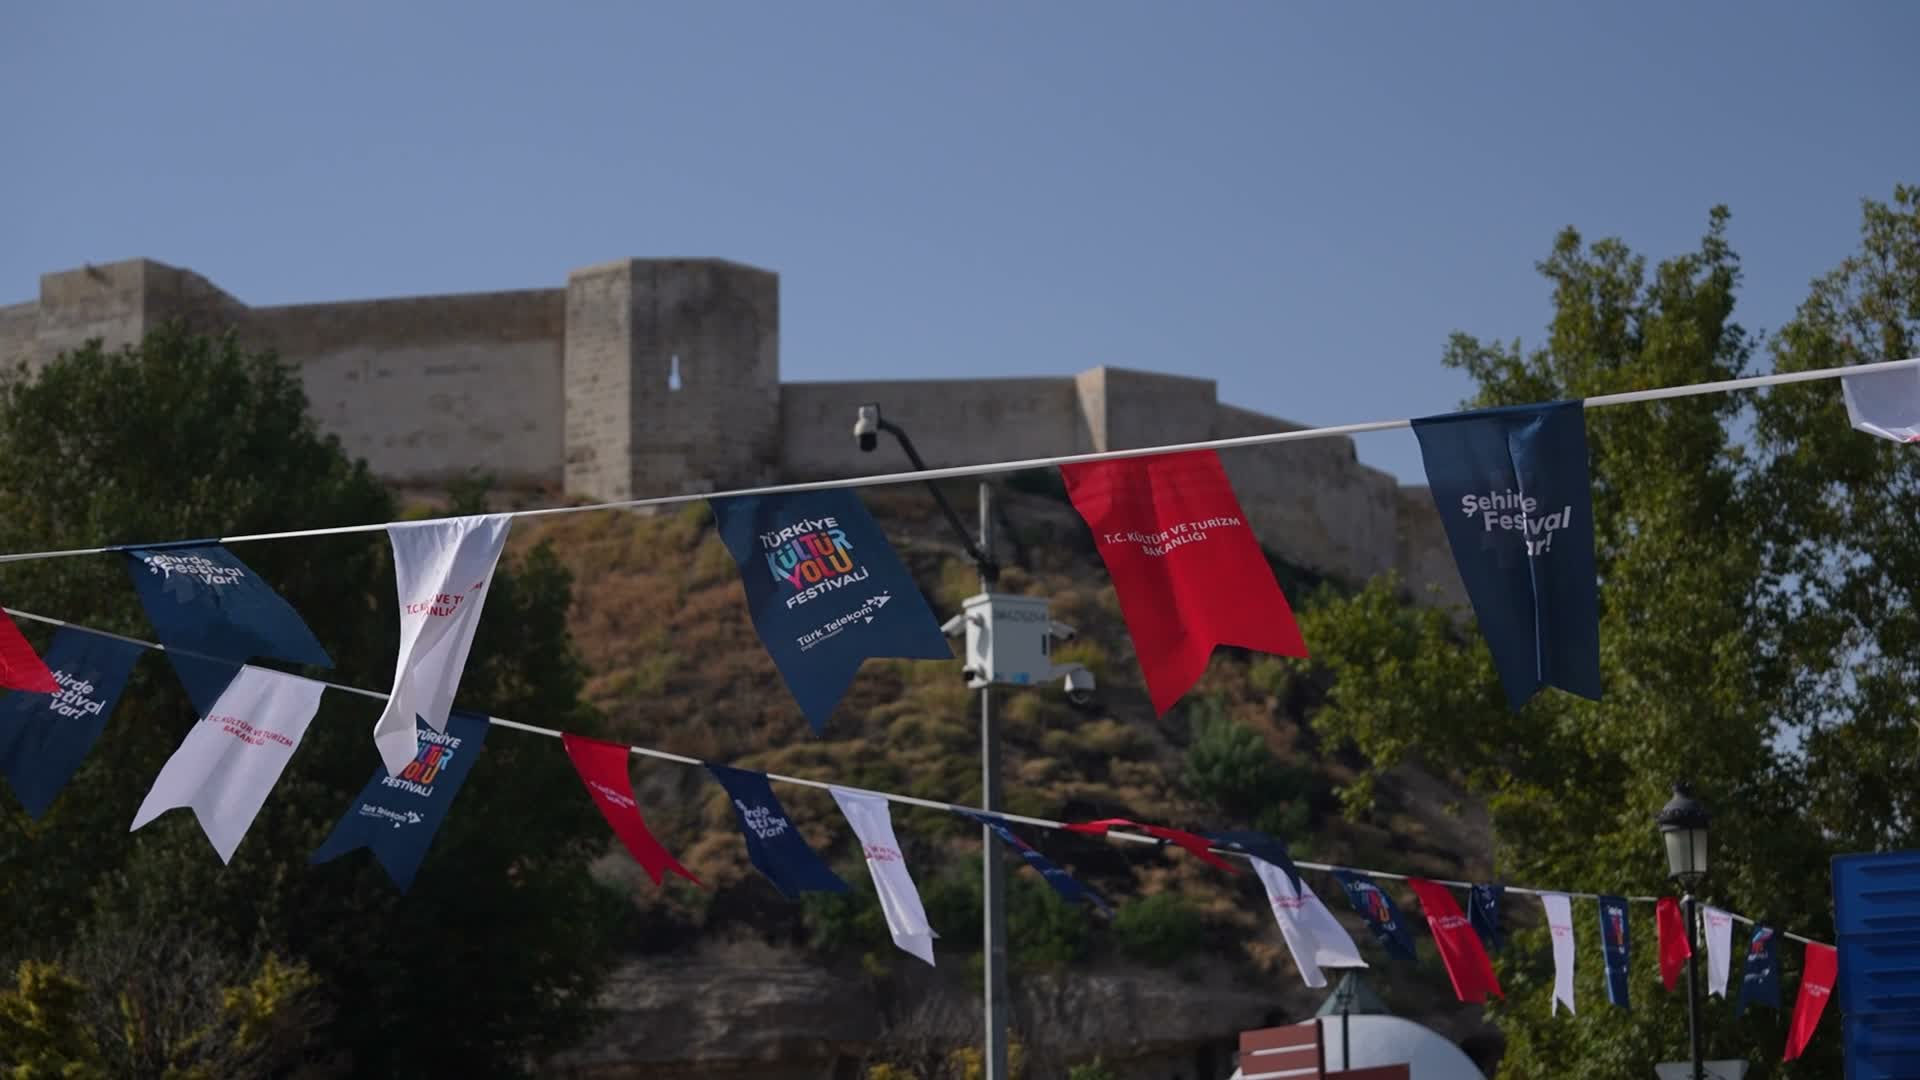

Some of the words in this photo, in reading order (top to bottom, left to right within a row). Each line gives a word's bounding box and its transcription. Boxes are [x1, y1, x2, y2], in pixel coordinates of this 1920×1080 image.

[1462, 489, 1537, 518] Şehire
[760, 517, 838, 549] TÜRKİYE
[1104, 533, 1127, 544] T.C.
[1127, 531, 1169, 545] KÜLTÜR
[1170, 523, 1188, 535] VE
[1190, 517, 1241, 531] TURİZM
[1484, 506, 1571, 535] Fesval
[765, 529, 853, 582] KÜLTÜR
[1142, 532, 1208, 557] BAKANLIĞI
[160, 562, 245, 579] Festival
[786, 547, 853, 590] YOLU
[786, 566, 869, 609] FESTİVALİ
[797, 628, 823, 646] Türk
[824, 605, 873, 631] Telekom
[50, 670, 94, 694] hirde
[49, 698, 88, 719] Var!
[51, 688, 106, 715] stival
[417, 729, 462, 749] TÜRKİYE
[381, 776, 434, 797] FESTİVALİ
[403, 762, 441, 784] OLU
